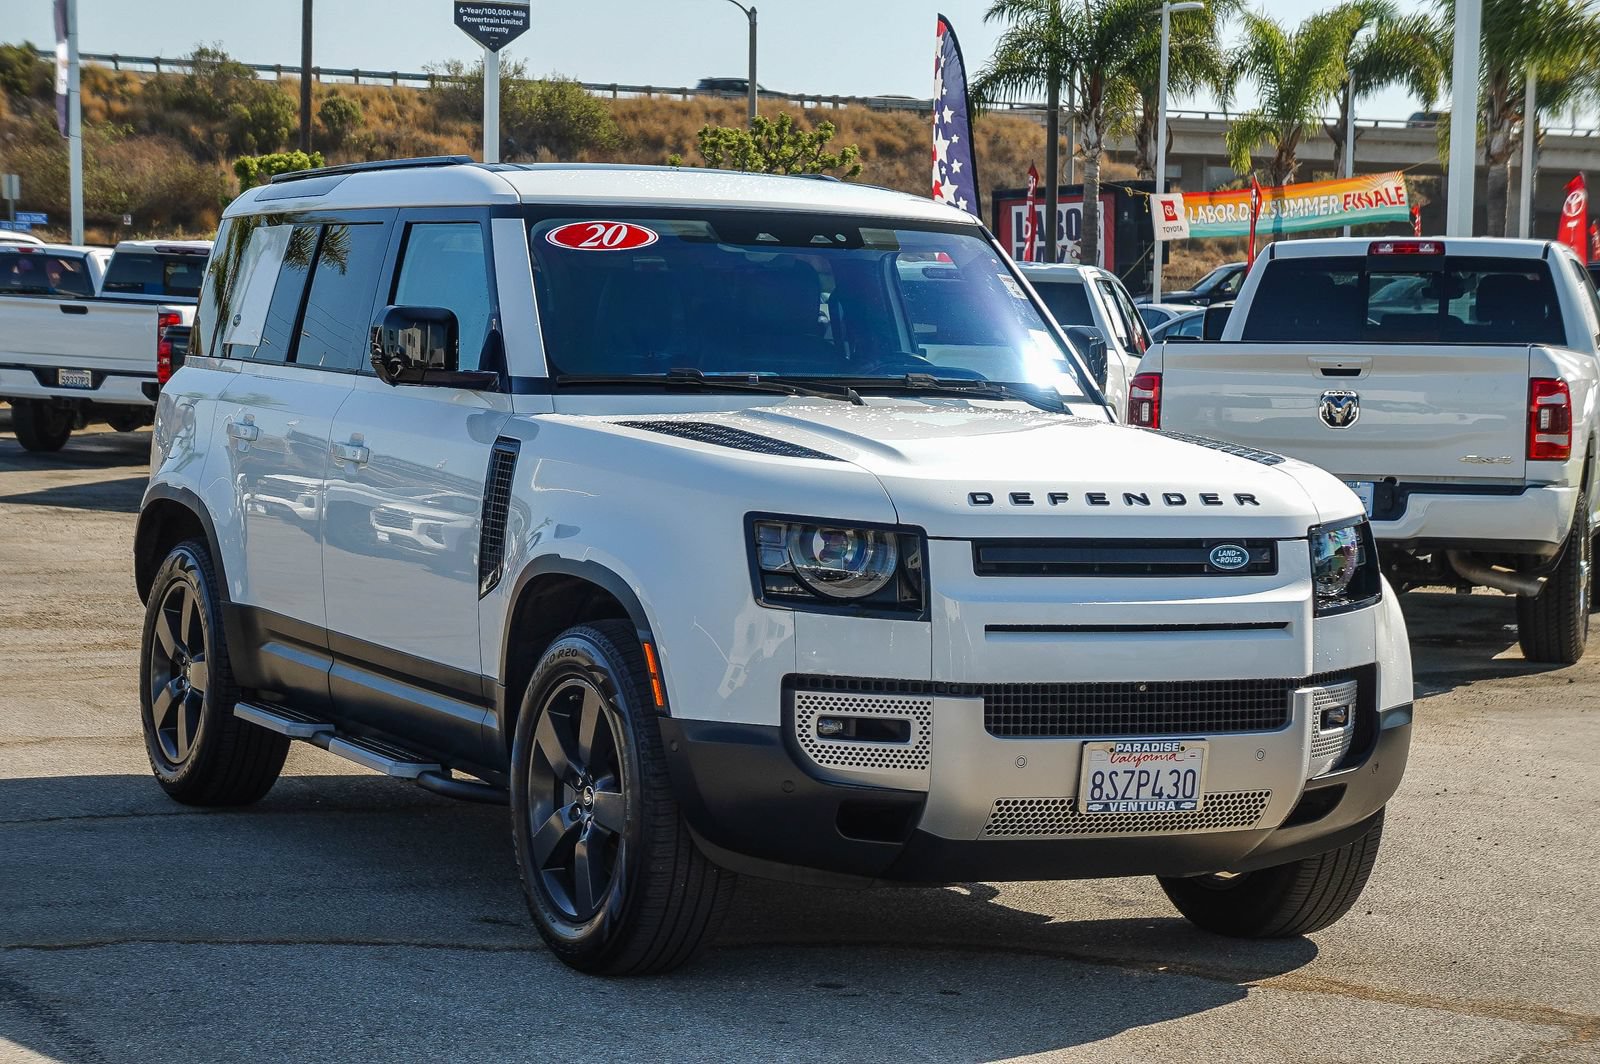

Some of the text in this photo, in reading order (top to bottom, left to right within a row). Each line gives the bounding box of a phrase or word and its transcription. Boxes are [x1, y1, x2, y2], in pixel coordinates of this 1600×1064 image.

[459, 7, 526, 17] 6-Year/100,000-Mile
[462, 16, 523, 26] Powertrain Limited
[478, 25, 509, 34] Warranty
[1189, 203, 1237, 224] LABOR
[1269, 193, 1339, 219] SUMMER
[1342, 185, 1406, 212] FINALE
[1162, 225, 1183, 233] TOYOTA
[578, 223, 629, 247] 20
[967, 491, 1261, 506] DEFENDER
[1115, 742, 1180, 752] PARADISE
[1110, 752, 1184, 768] California
[1090, 768, 1197, 801] 8SZP430
[1109, 801, 1176, 812] VENTURA
